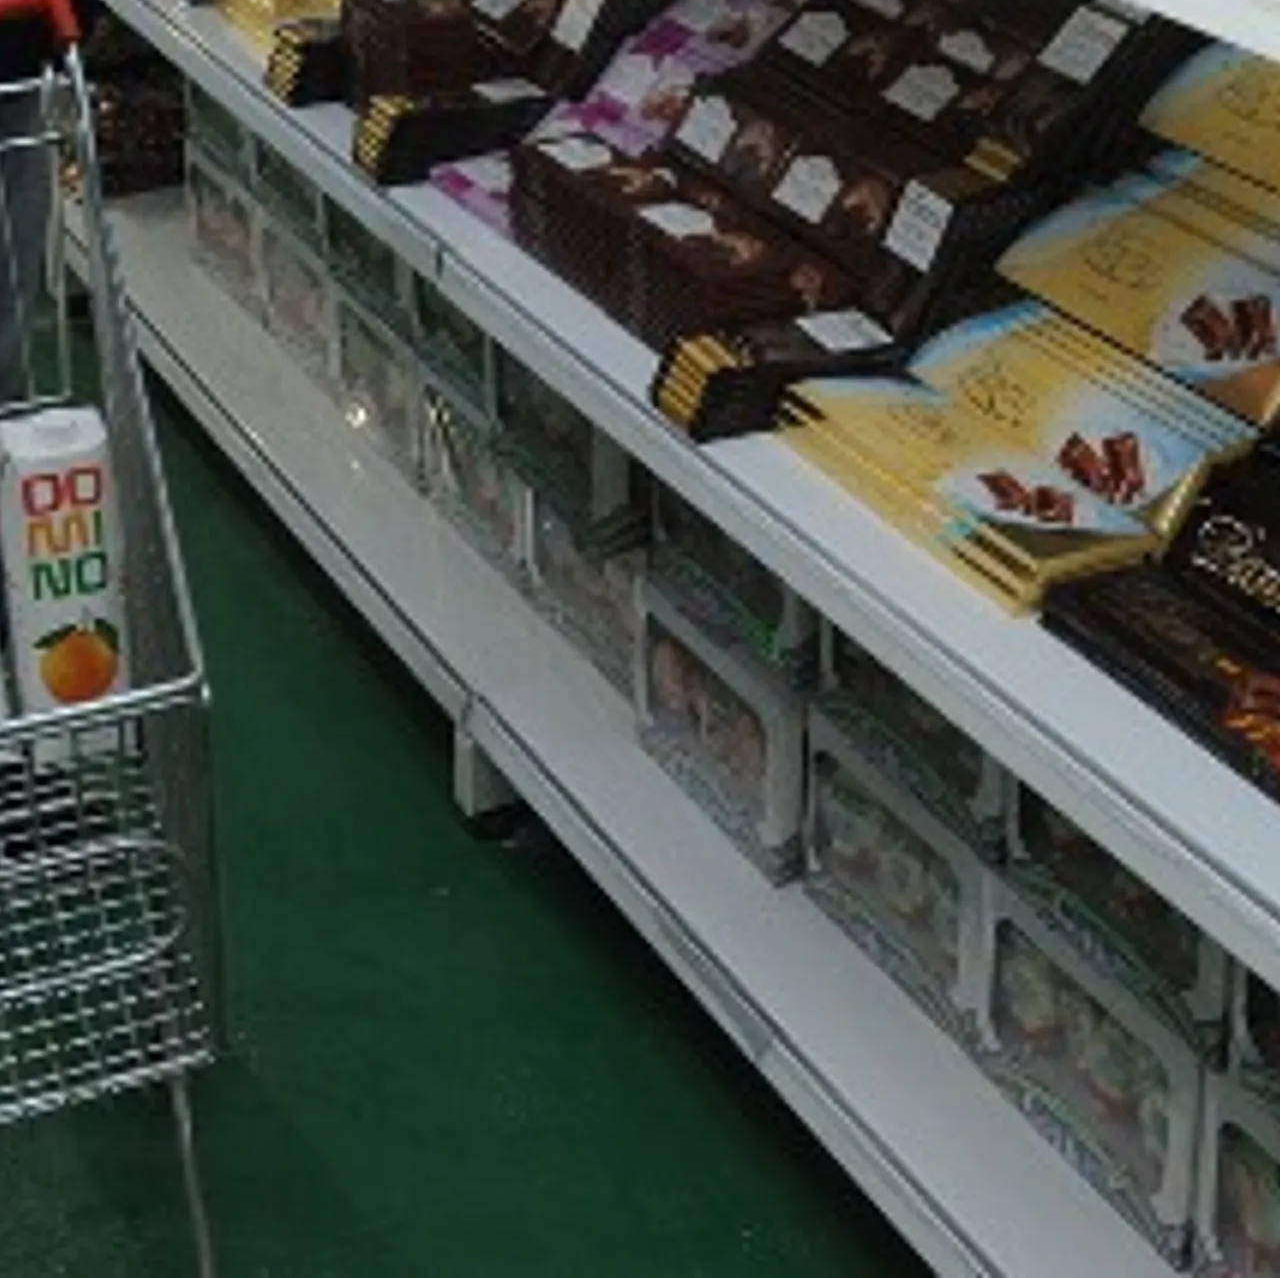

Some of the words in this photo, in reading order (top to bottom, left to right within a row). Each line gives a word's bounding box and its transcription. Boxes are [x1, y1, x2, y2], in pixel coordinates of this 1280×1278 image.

[21, 467, 104, 516] DO
[27, 510, 103, 557] MI
[32, 549, 109, 600] NO
